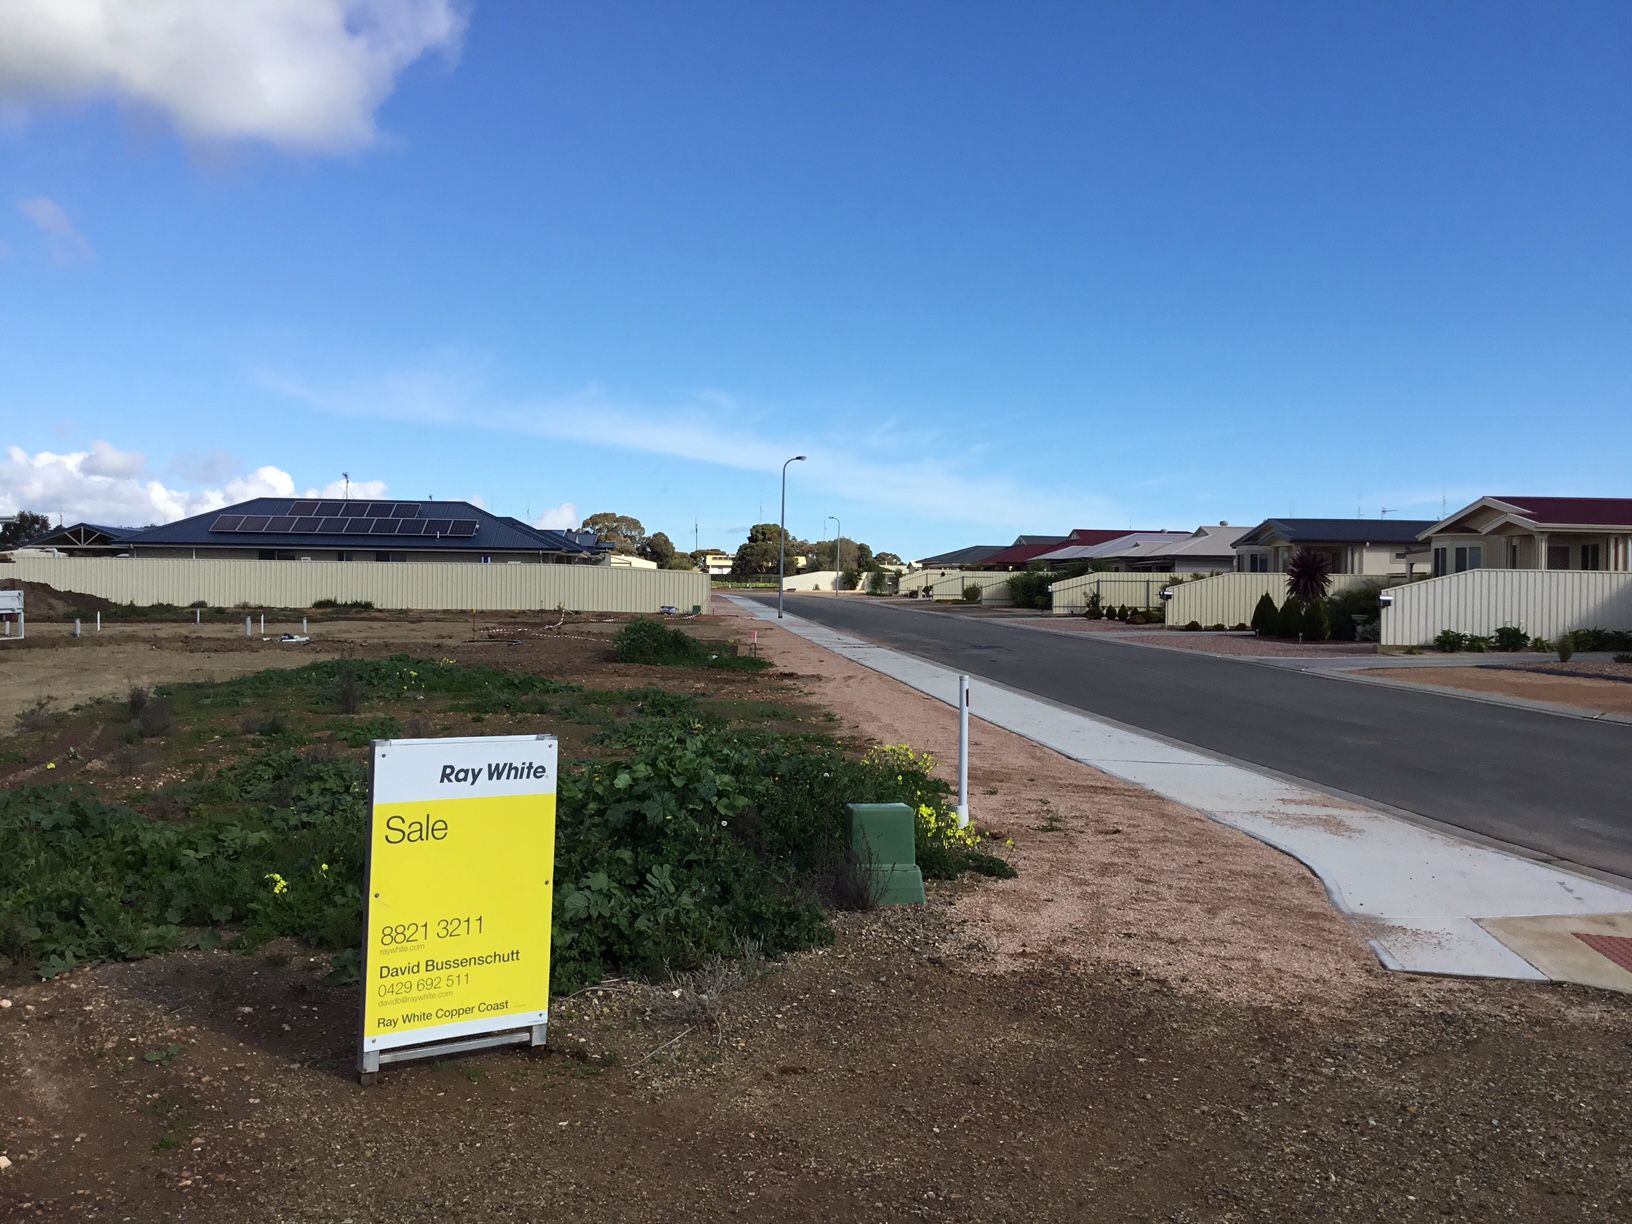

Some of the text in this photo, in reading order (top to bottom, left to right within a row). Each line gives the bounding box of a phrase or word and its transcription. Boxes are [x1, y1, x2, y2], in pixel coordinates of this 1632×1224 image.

[439, 761, 547, 786] Ray White
[384, 813, 449, 844] Sale
[380, 915, 483, 946] 8821 3211
[379, 944, 426, 955] raywhite.com
[379, 949, 520, 979] David Bussenschutt
[377, 972, 470, 998] 0429 692 511
[377, 1017, 399, 1029] Ray
[401, 1011, 433, 1025] White
[435, 1005, 476, 1020] Copper
[477, 999, 509, 1013] Coast
